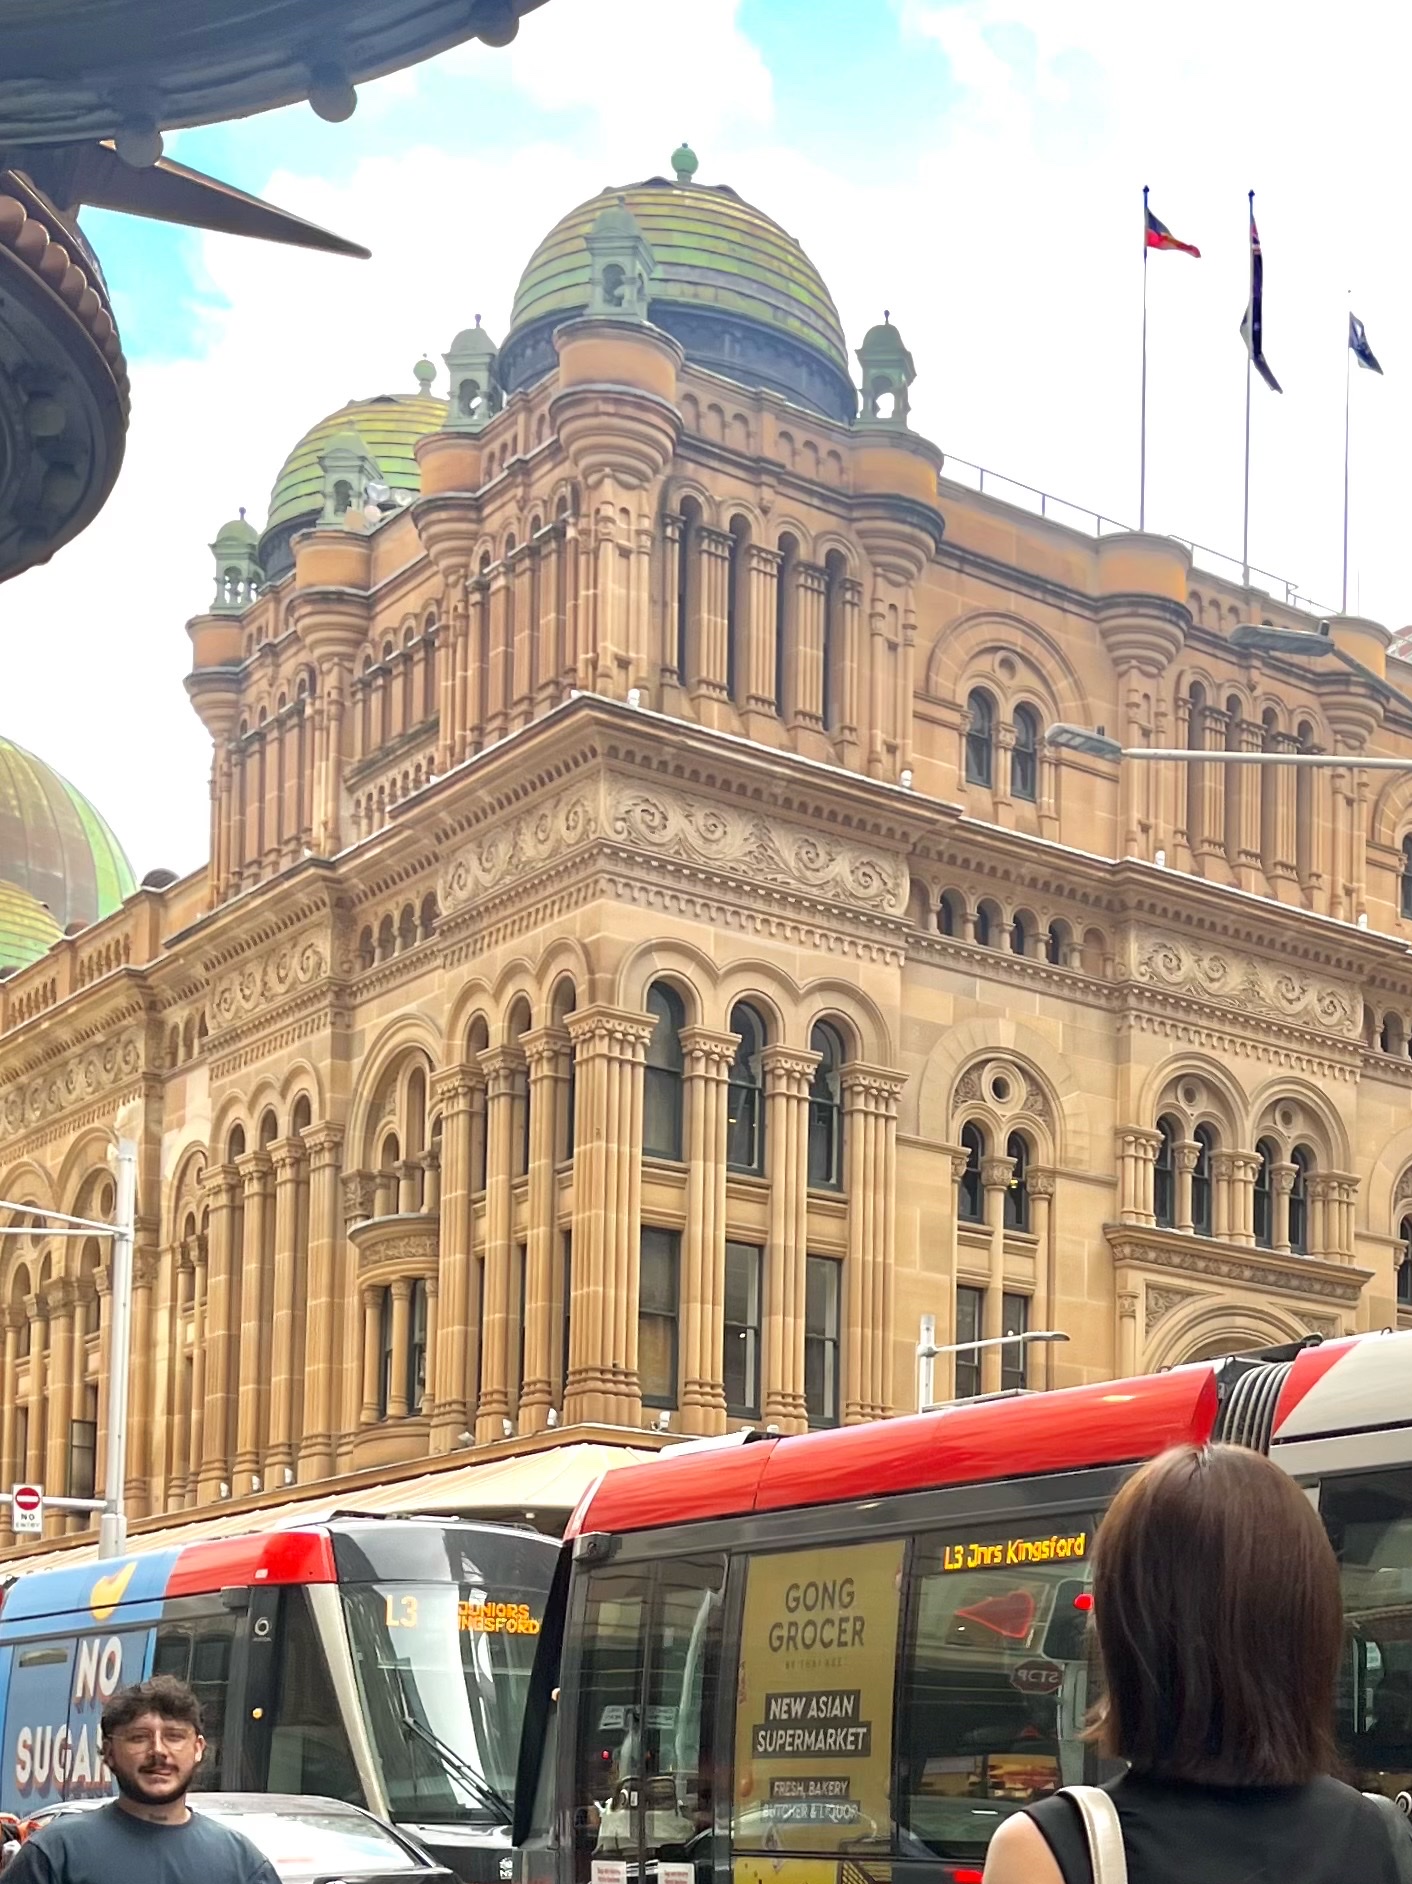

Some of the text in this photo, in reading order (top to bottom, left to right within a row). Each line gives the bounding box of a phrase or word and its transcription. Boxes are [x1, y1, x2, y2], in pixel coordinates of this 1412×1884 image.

[944, 1532, 1086, 1570] L3 Jnrs Kingsford
[386, 1594, 418, 1627] L3
[785, 1577, 855, 1613] GONG
[458, 1615, 540, 1635] INGSFORD
[768, 1615, 865, 1653] GROCER
[76, 1636, 123, 1697] NO
[769, 1695, 855, 1720] NEW ASIAN
[757, 1726, 867, 1752] SUPERMARKET
[808, 1780, 848, 1796] BAKERY
